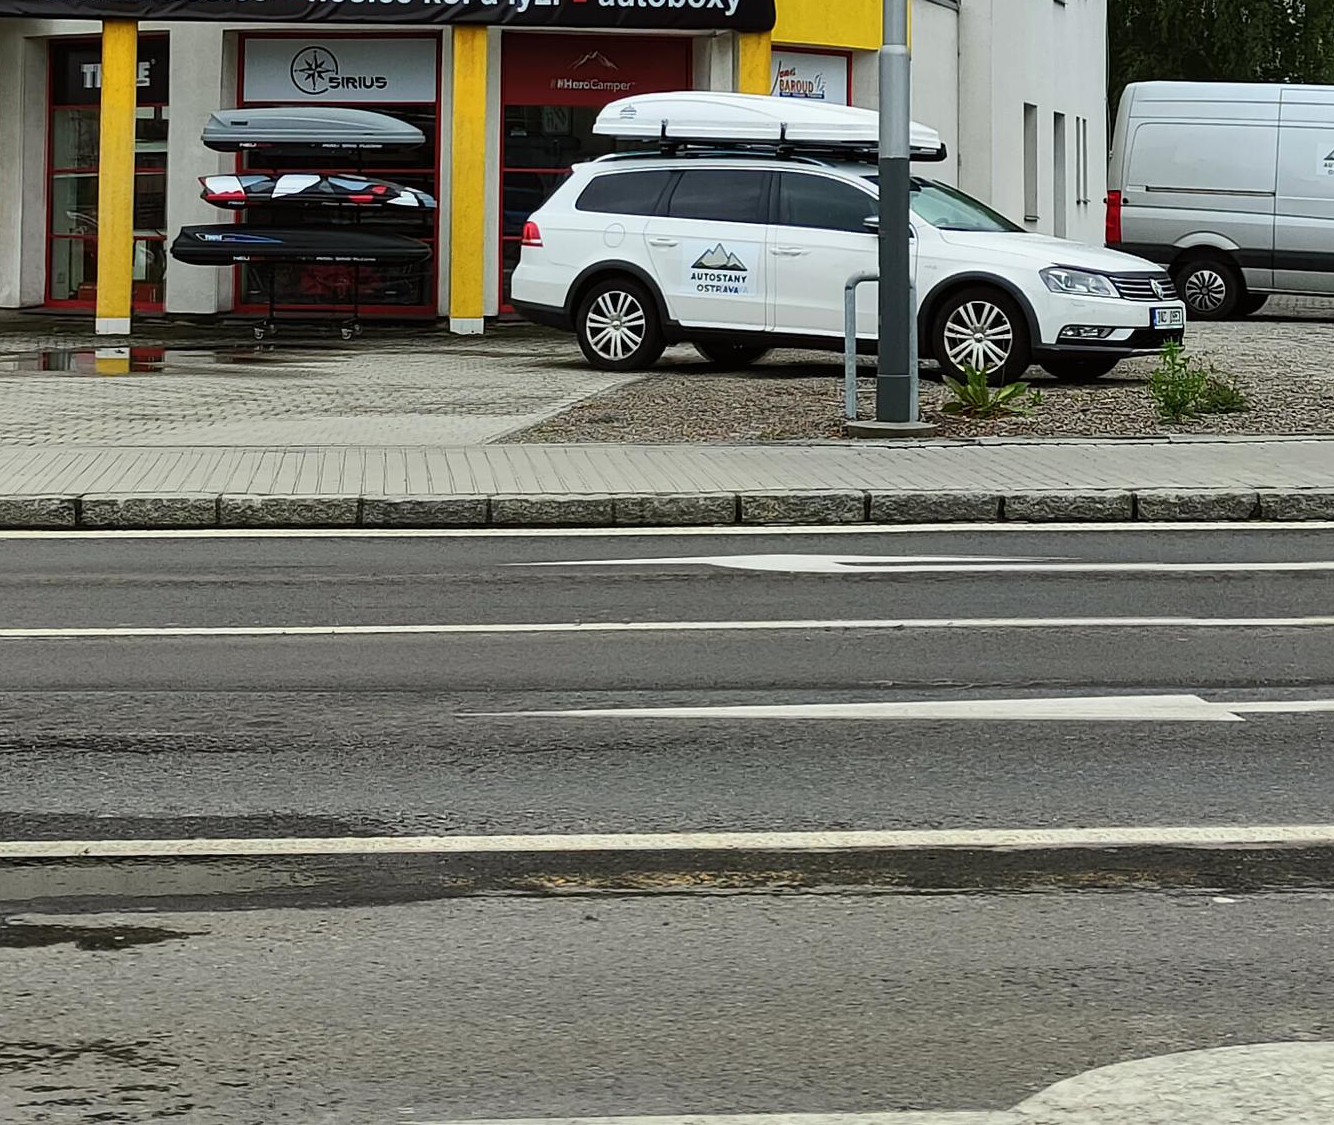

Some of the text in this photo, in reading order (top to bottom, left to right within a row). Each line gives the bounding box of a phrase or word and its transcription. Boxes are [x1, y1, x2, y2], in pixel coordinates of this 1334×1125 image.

[328, 76, 388, 89] SIRIUS
[779, 79, 815, 93] BAROUD
[691, 272, 747, 283] AUTOSTANY
